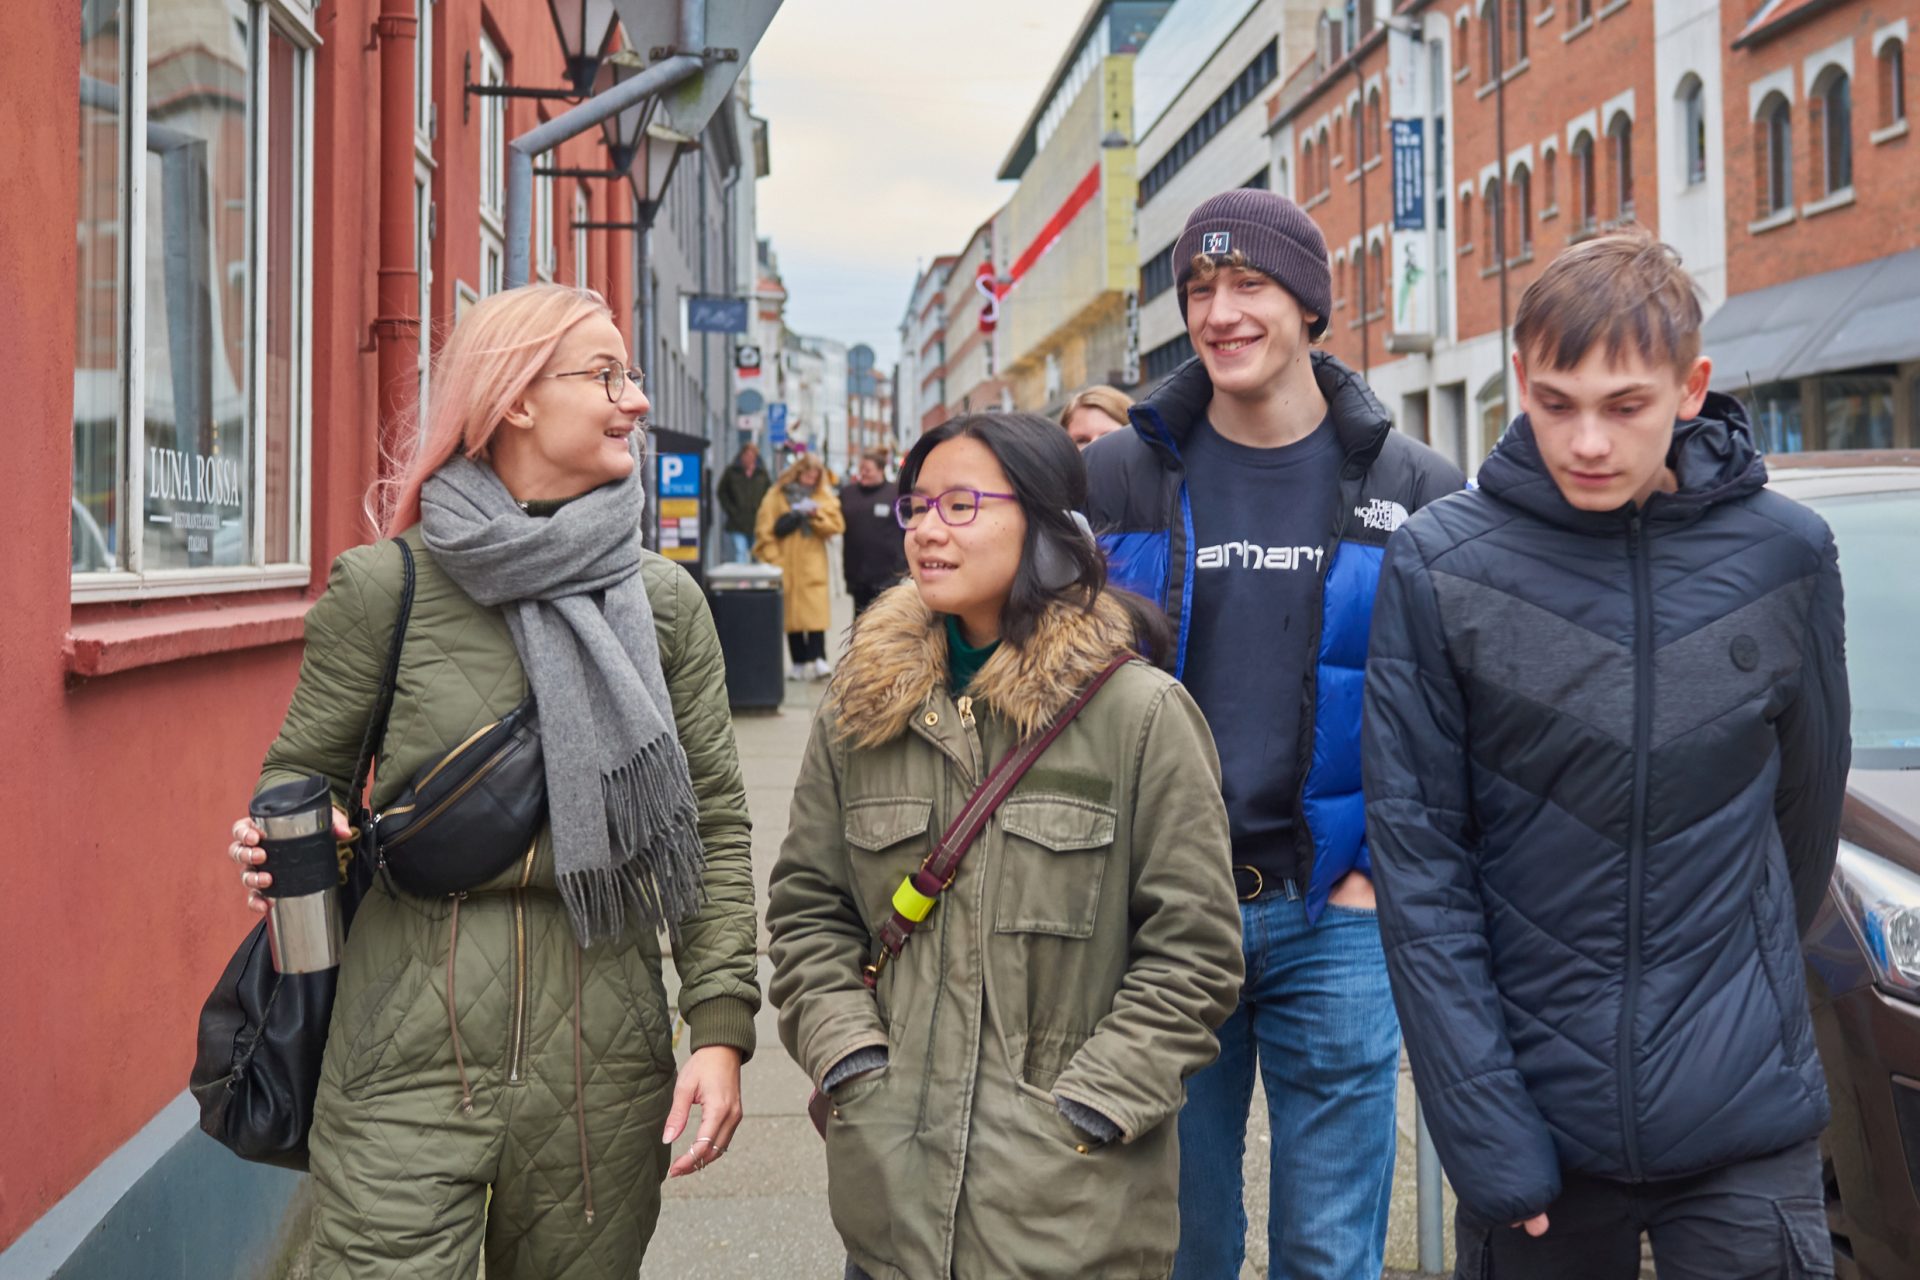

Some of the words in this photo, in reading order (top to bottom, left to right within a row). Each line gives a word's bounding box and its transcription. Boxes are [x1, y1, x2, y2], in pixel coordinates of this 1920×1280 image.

[150, 447, 192, 501] LUNA
[196, 454, 239, 506] ROSSA
[661, 455, 684, 486] P
[1369, 498, 1392, 510] THE
[1354, 506, 1392, 521] NORTH
[1363, 517, 1392, 532] FACE
